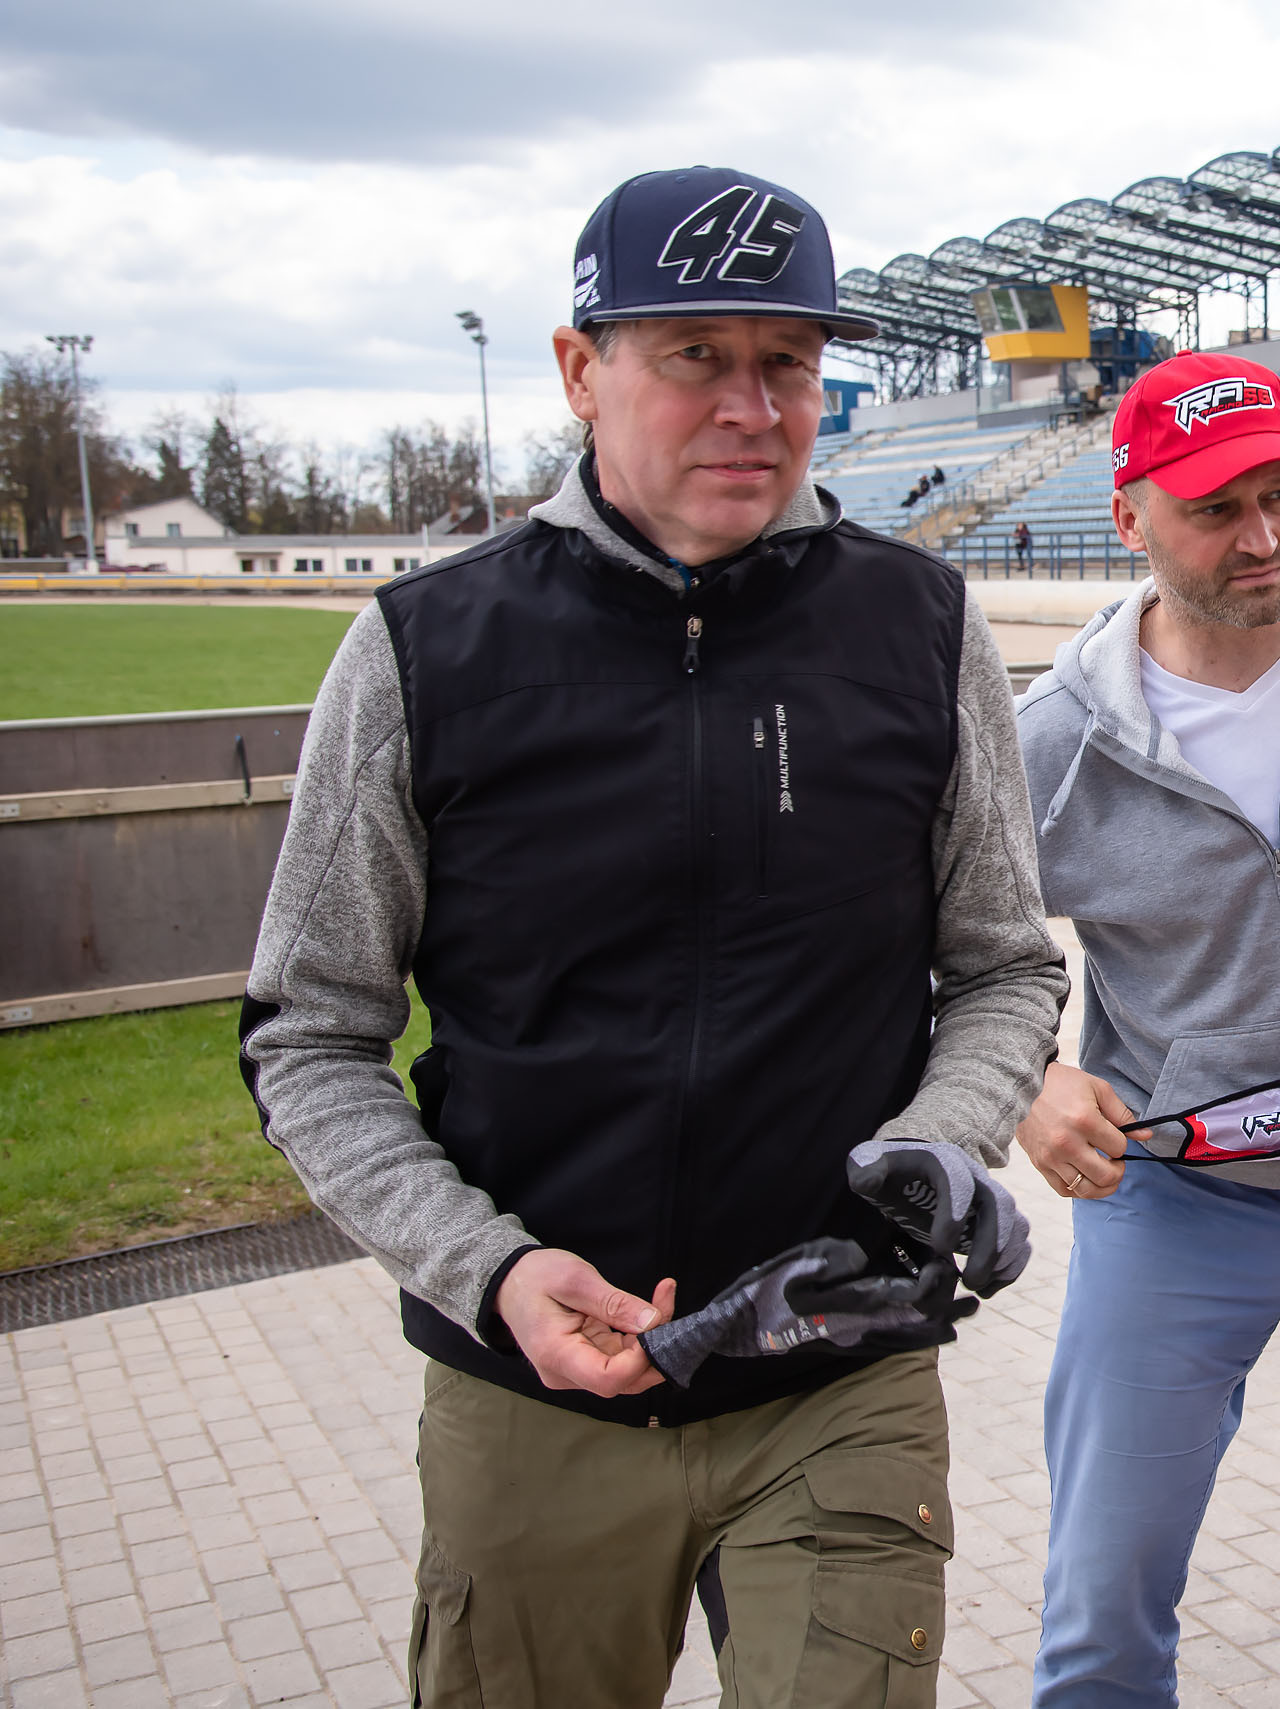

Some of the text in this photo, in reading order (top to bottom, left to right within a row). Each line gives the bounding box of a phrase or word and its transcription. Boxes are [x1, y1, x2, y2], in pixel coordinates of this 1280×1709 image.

[656, 184, 806, 284] 45
[1200, 401, 1244, 417] RACING
[775, 704, 790, 789] MULTIFUNCTION
